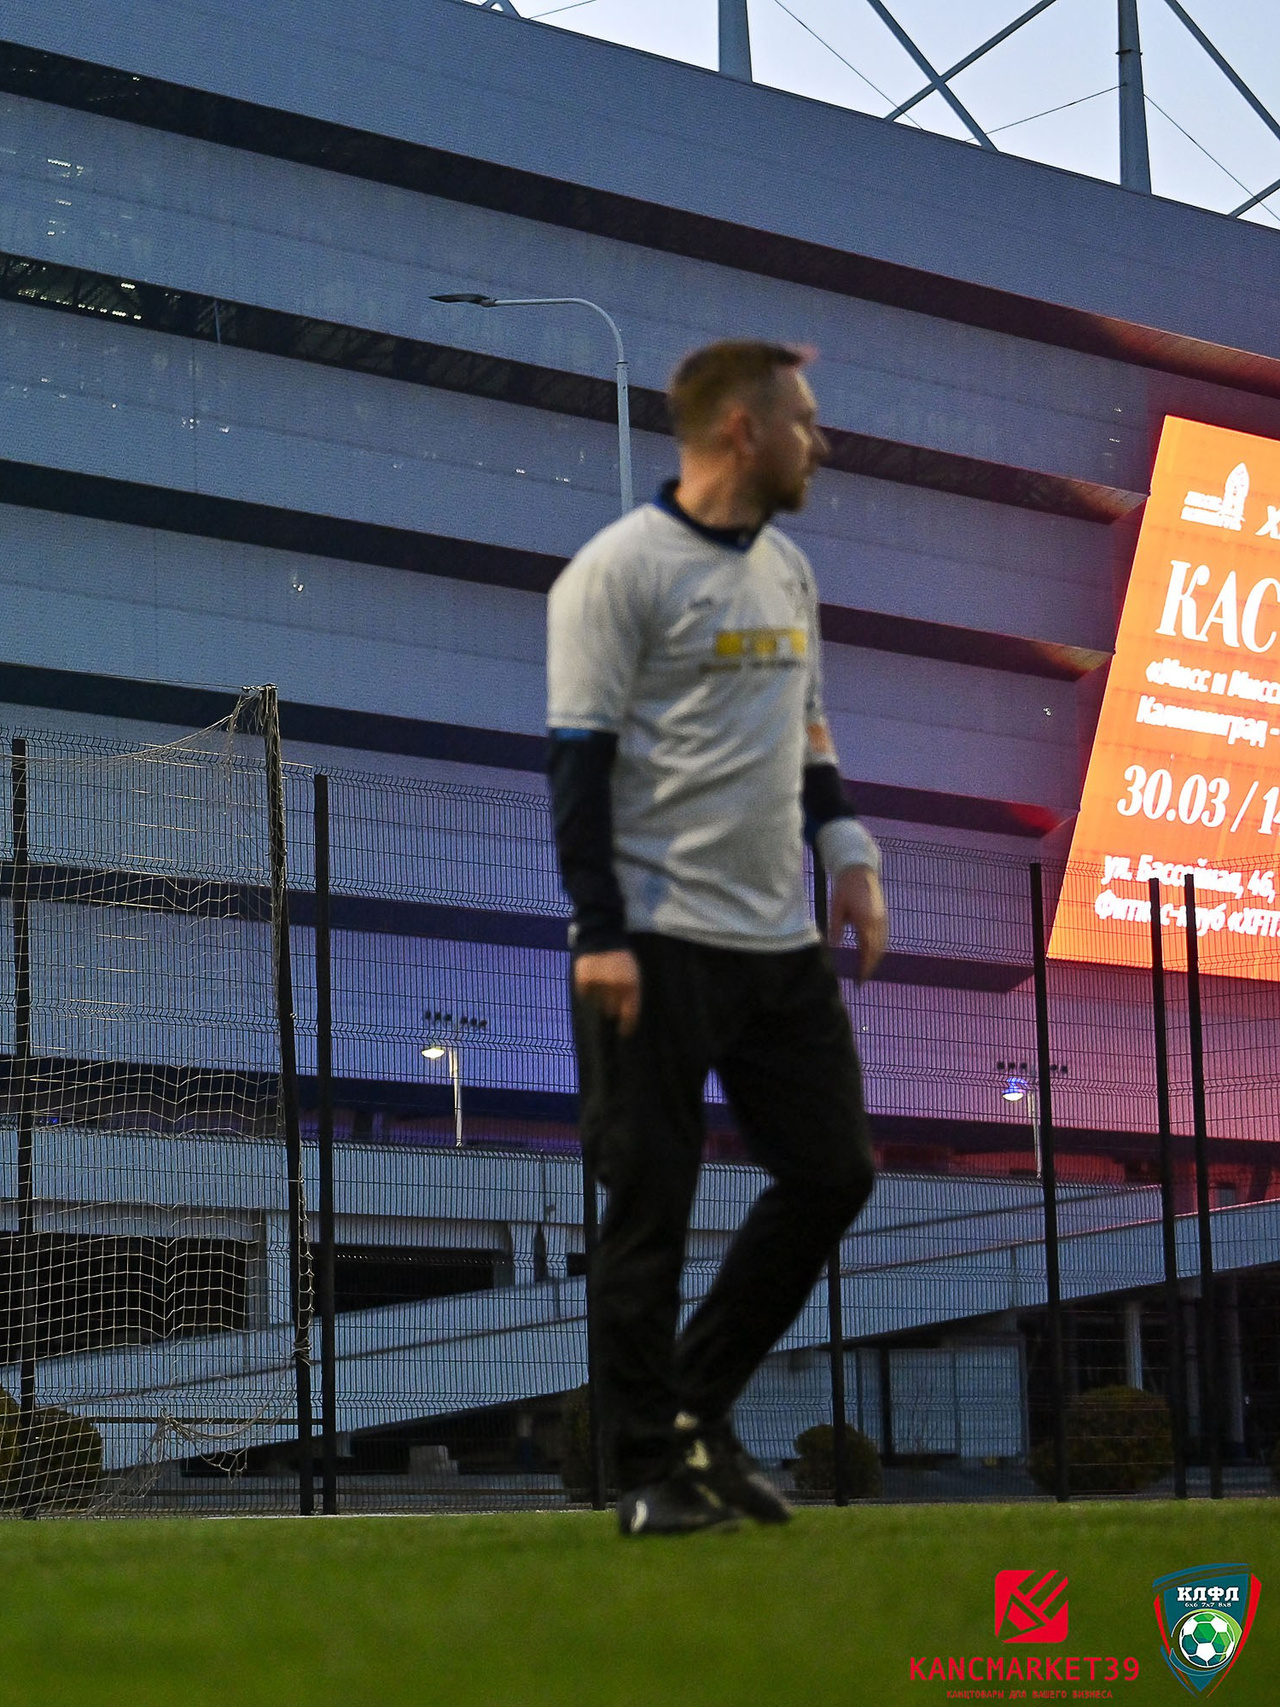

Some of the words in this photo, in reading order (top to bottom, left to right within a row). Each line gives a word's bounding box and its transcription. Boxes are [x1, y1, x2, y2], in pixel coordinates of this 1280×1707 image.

[1116, 764, 1230, 828] 30.03
[1101, 855, 1132, 885] ул.
[1247, 869, 1276, 904] 46,
[1094, 889, 1226, 937] Фитнс-клуб
